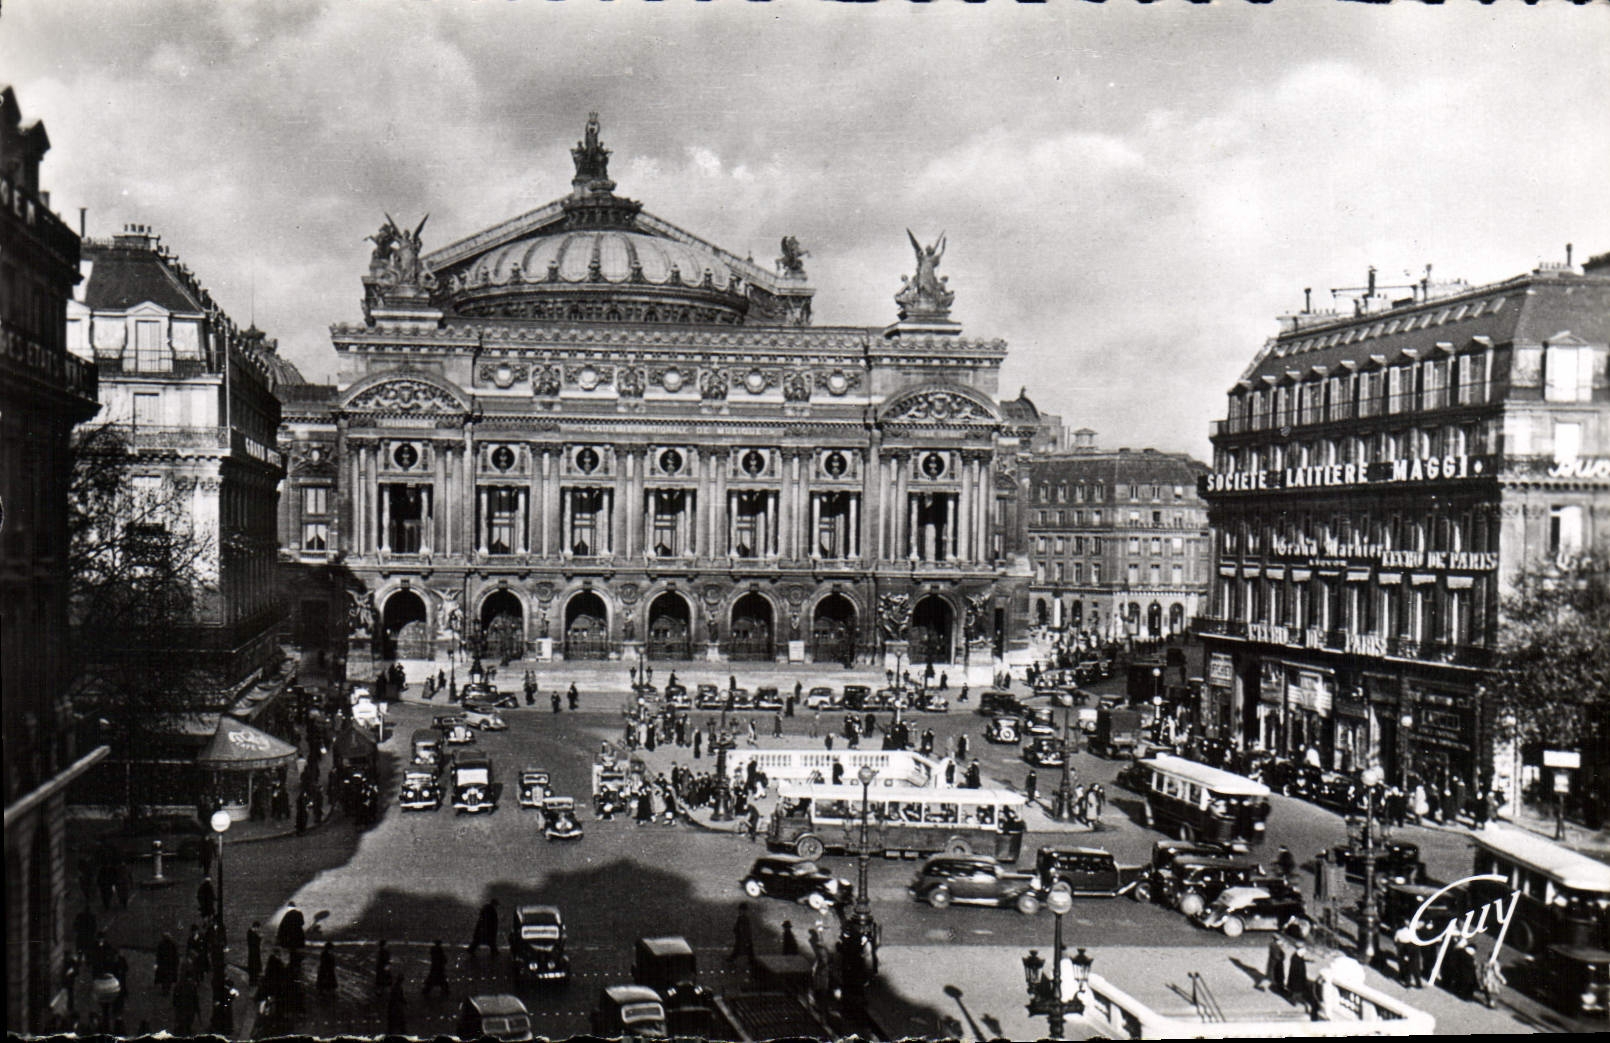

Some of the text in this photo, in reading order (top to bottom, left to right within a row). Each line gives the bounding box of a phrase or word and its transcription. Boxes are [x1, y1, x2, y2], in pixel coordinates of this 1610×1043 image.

[1392, 455, 1468, 481] MAGGI
[1449, 551, 1498, 571] PARIS
[1344, 634, 1388, 657] PARIS
